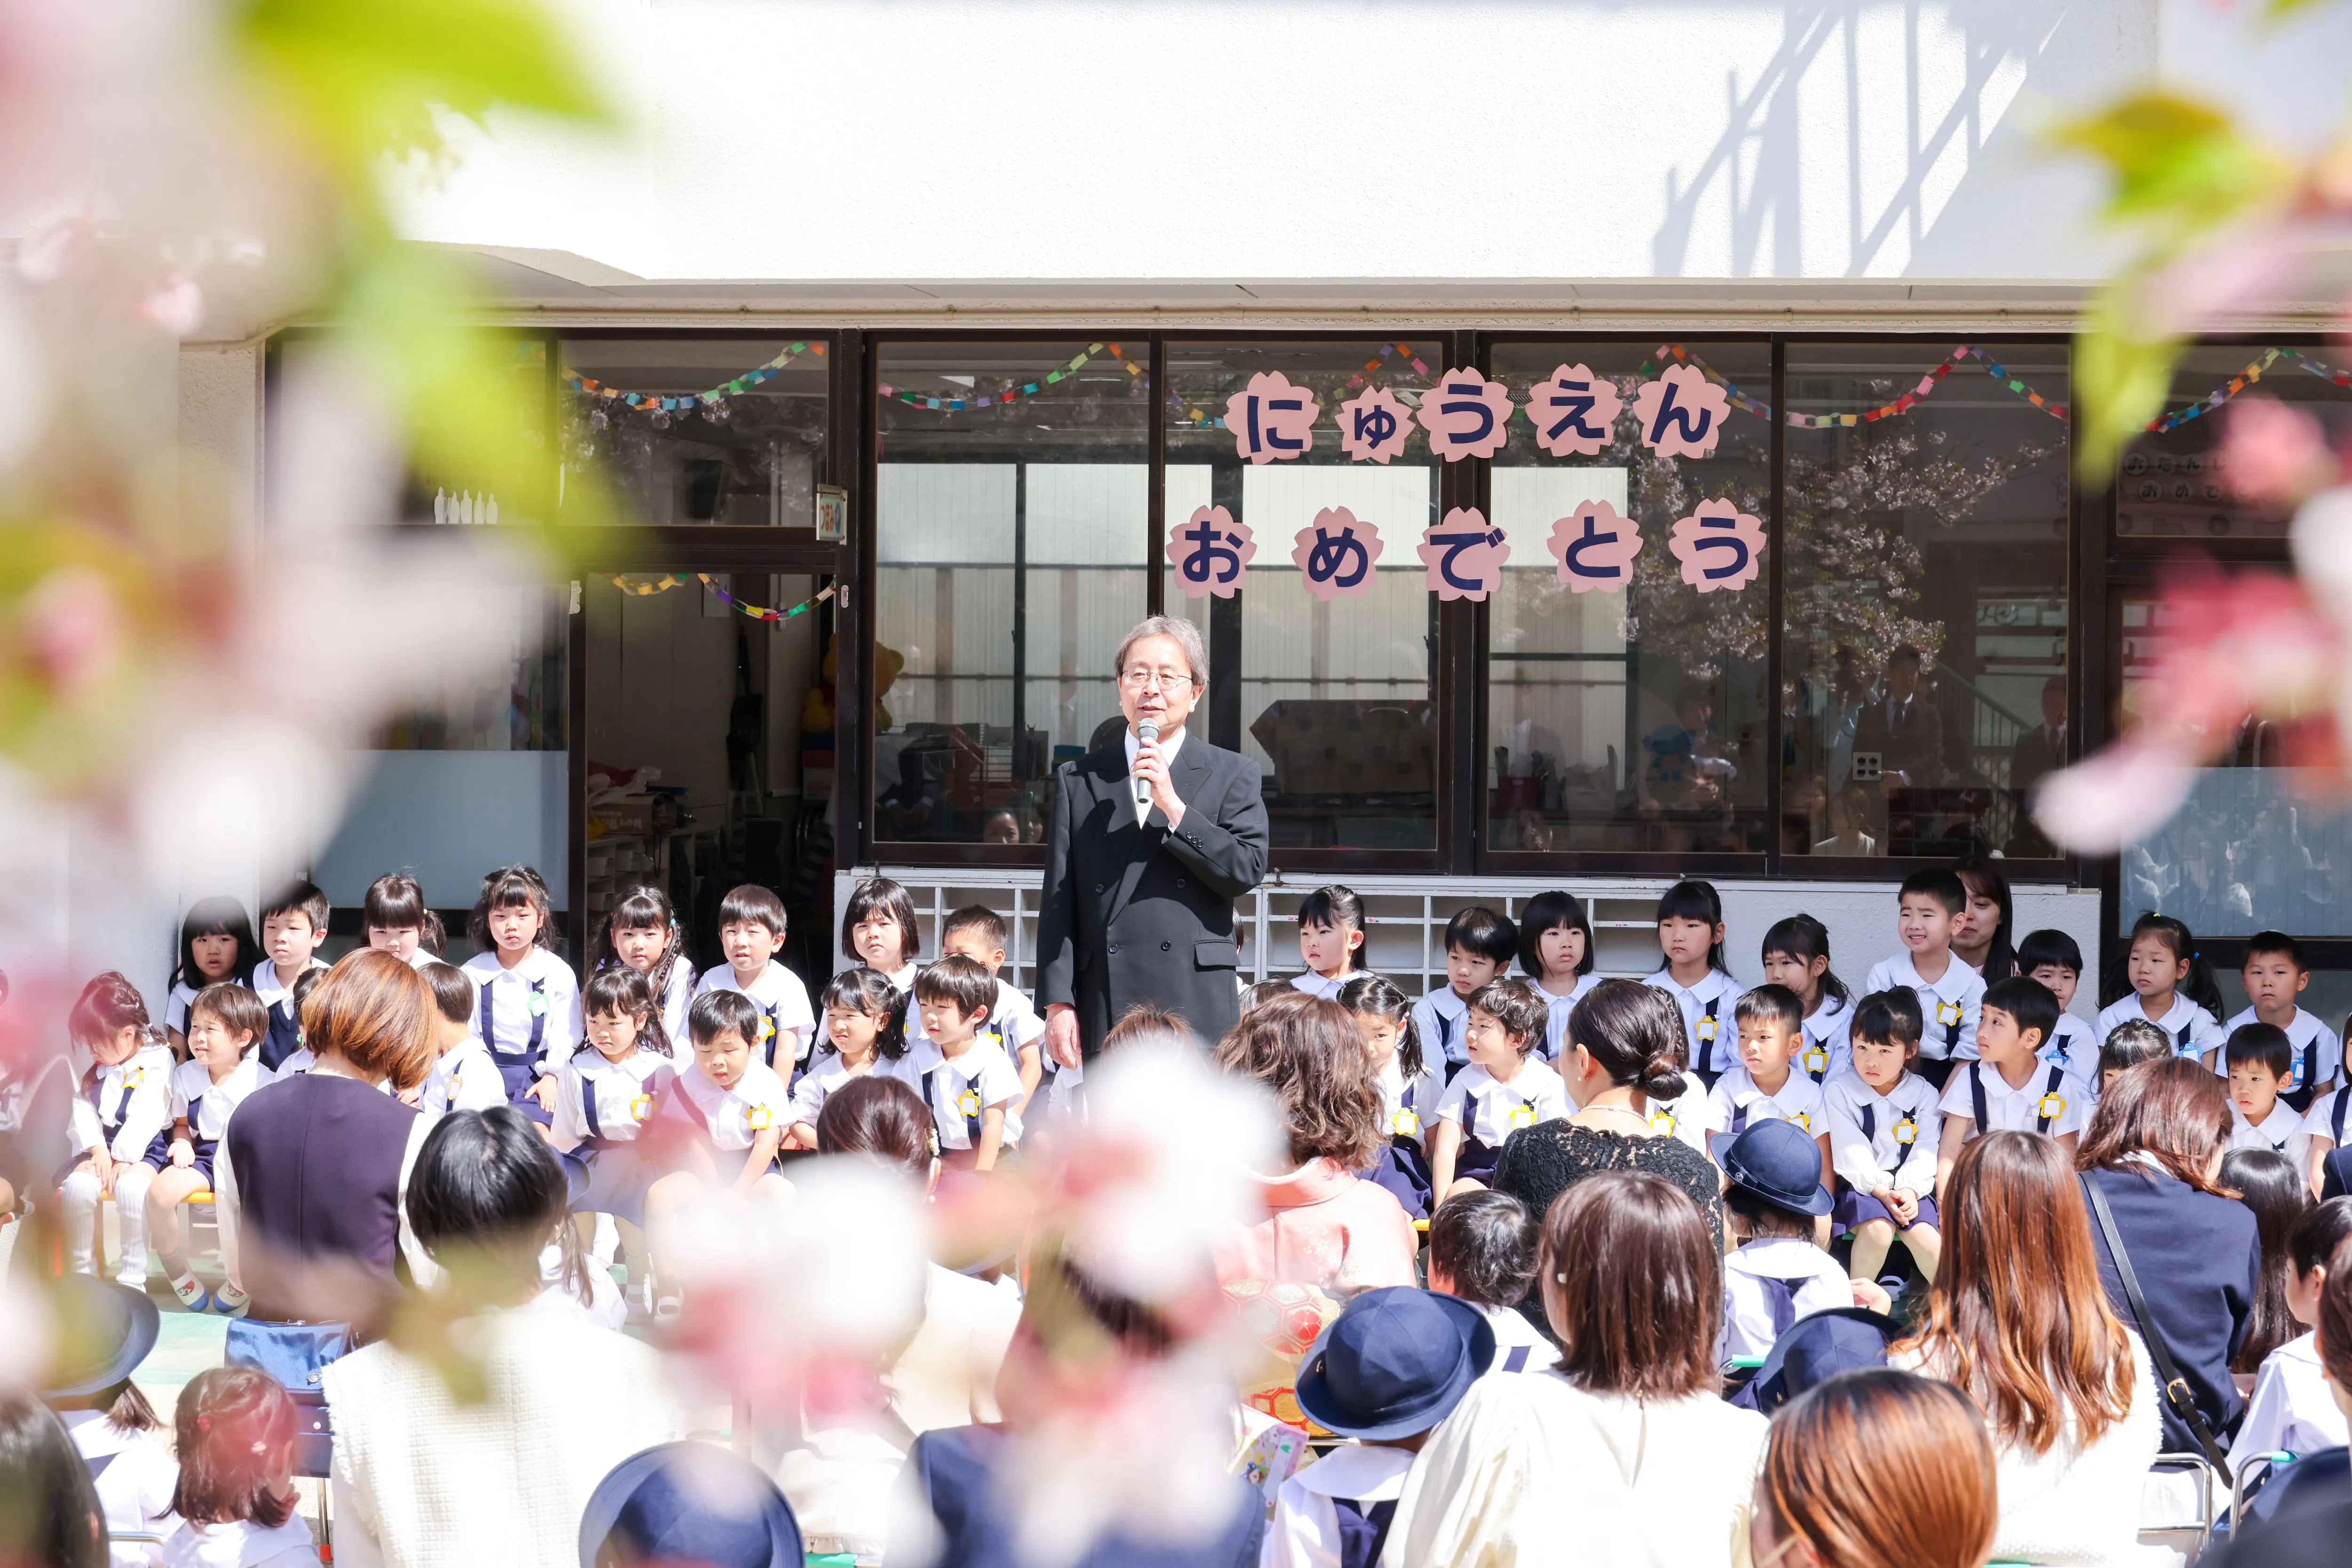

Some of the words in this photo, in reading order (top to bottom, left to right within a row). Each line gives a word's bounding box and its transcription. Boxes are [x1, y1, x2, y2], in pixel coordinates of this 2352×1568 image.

[1247, 379, 1711, 453] にゅうえん
[820, 503, 834, 532] つぼみ
[1183, 516, 1748, 591] おめでとう
